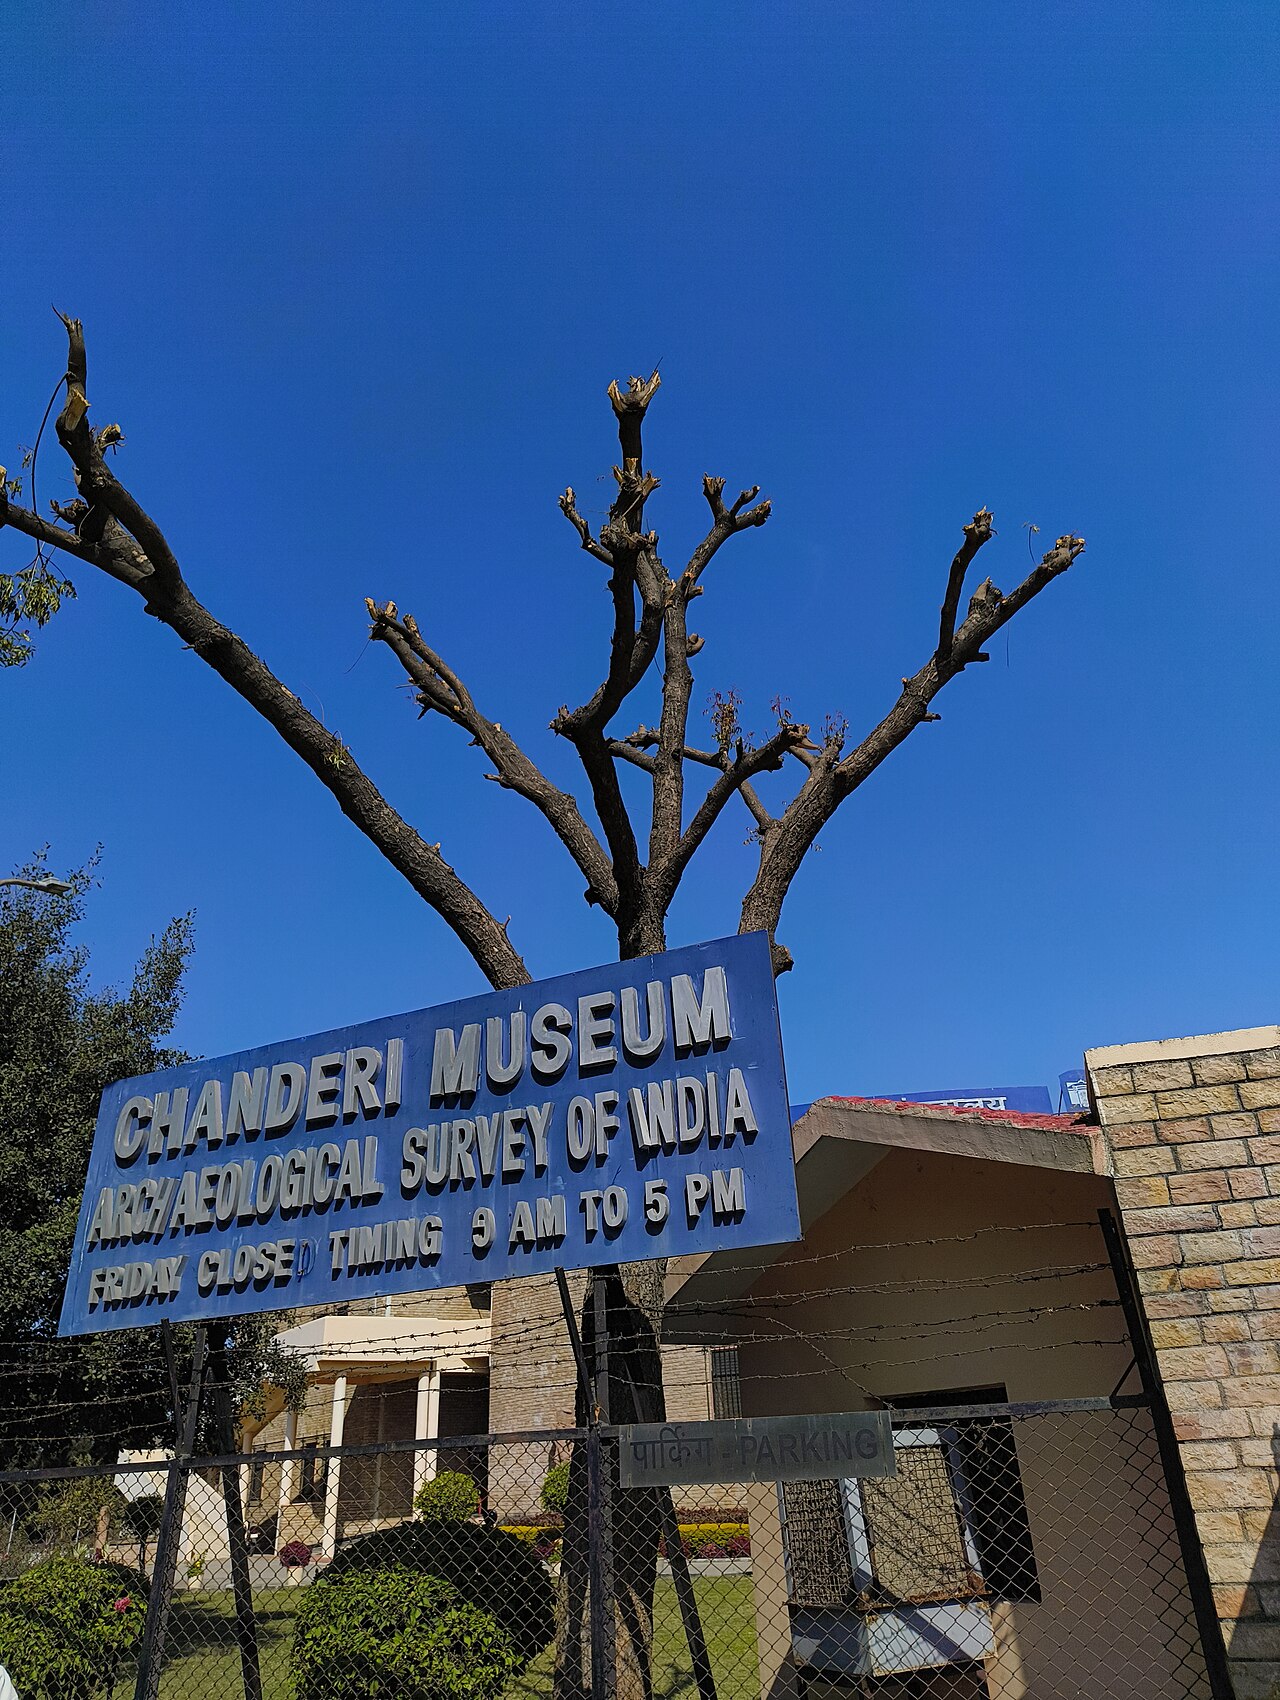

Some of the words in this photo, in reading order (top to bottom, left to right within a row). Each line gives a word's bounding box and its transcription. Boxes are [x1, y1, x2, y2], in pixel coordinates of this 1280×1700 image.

[113, 1037, 403, 1160] CHANDERI
[430, 966, 732, 1097] MUSEUM
[87, 1136, 384, 1243] ARCHAEOLOGICAL
[401, 1102, 554, 1189] SURVEY
[567, 1090, 620, 1160] OF
[628, 1068, 758, 1150] INDIA
[88, 1255, 188, 1304] FRIDAY
[329, 1215, 443, 1270] TIMING
[472, 1207, 496, 1249] 9
[508, 1195, 567, 1242] AM
[580, 1185, 629, 1231] TO
[645, 1178, 670, 1223] 5
[686, 1167, 747, 1217] PM
[740, 1428, 878, 1466] PARKING
